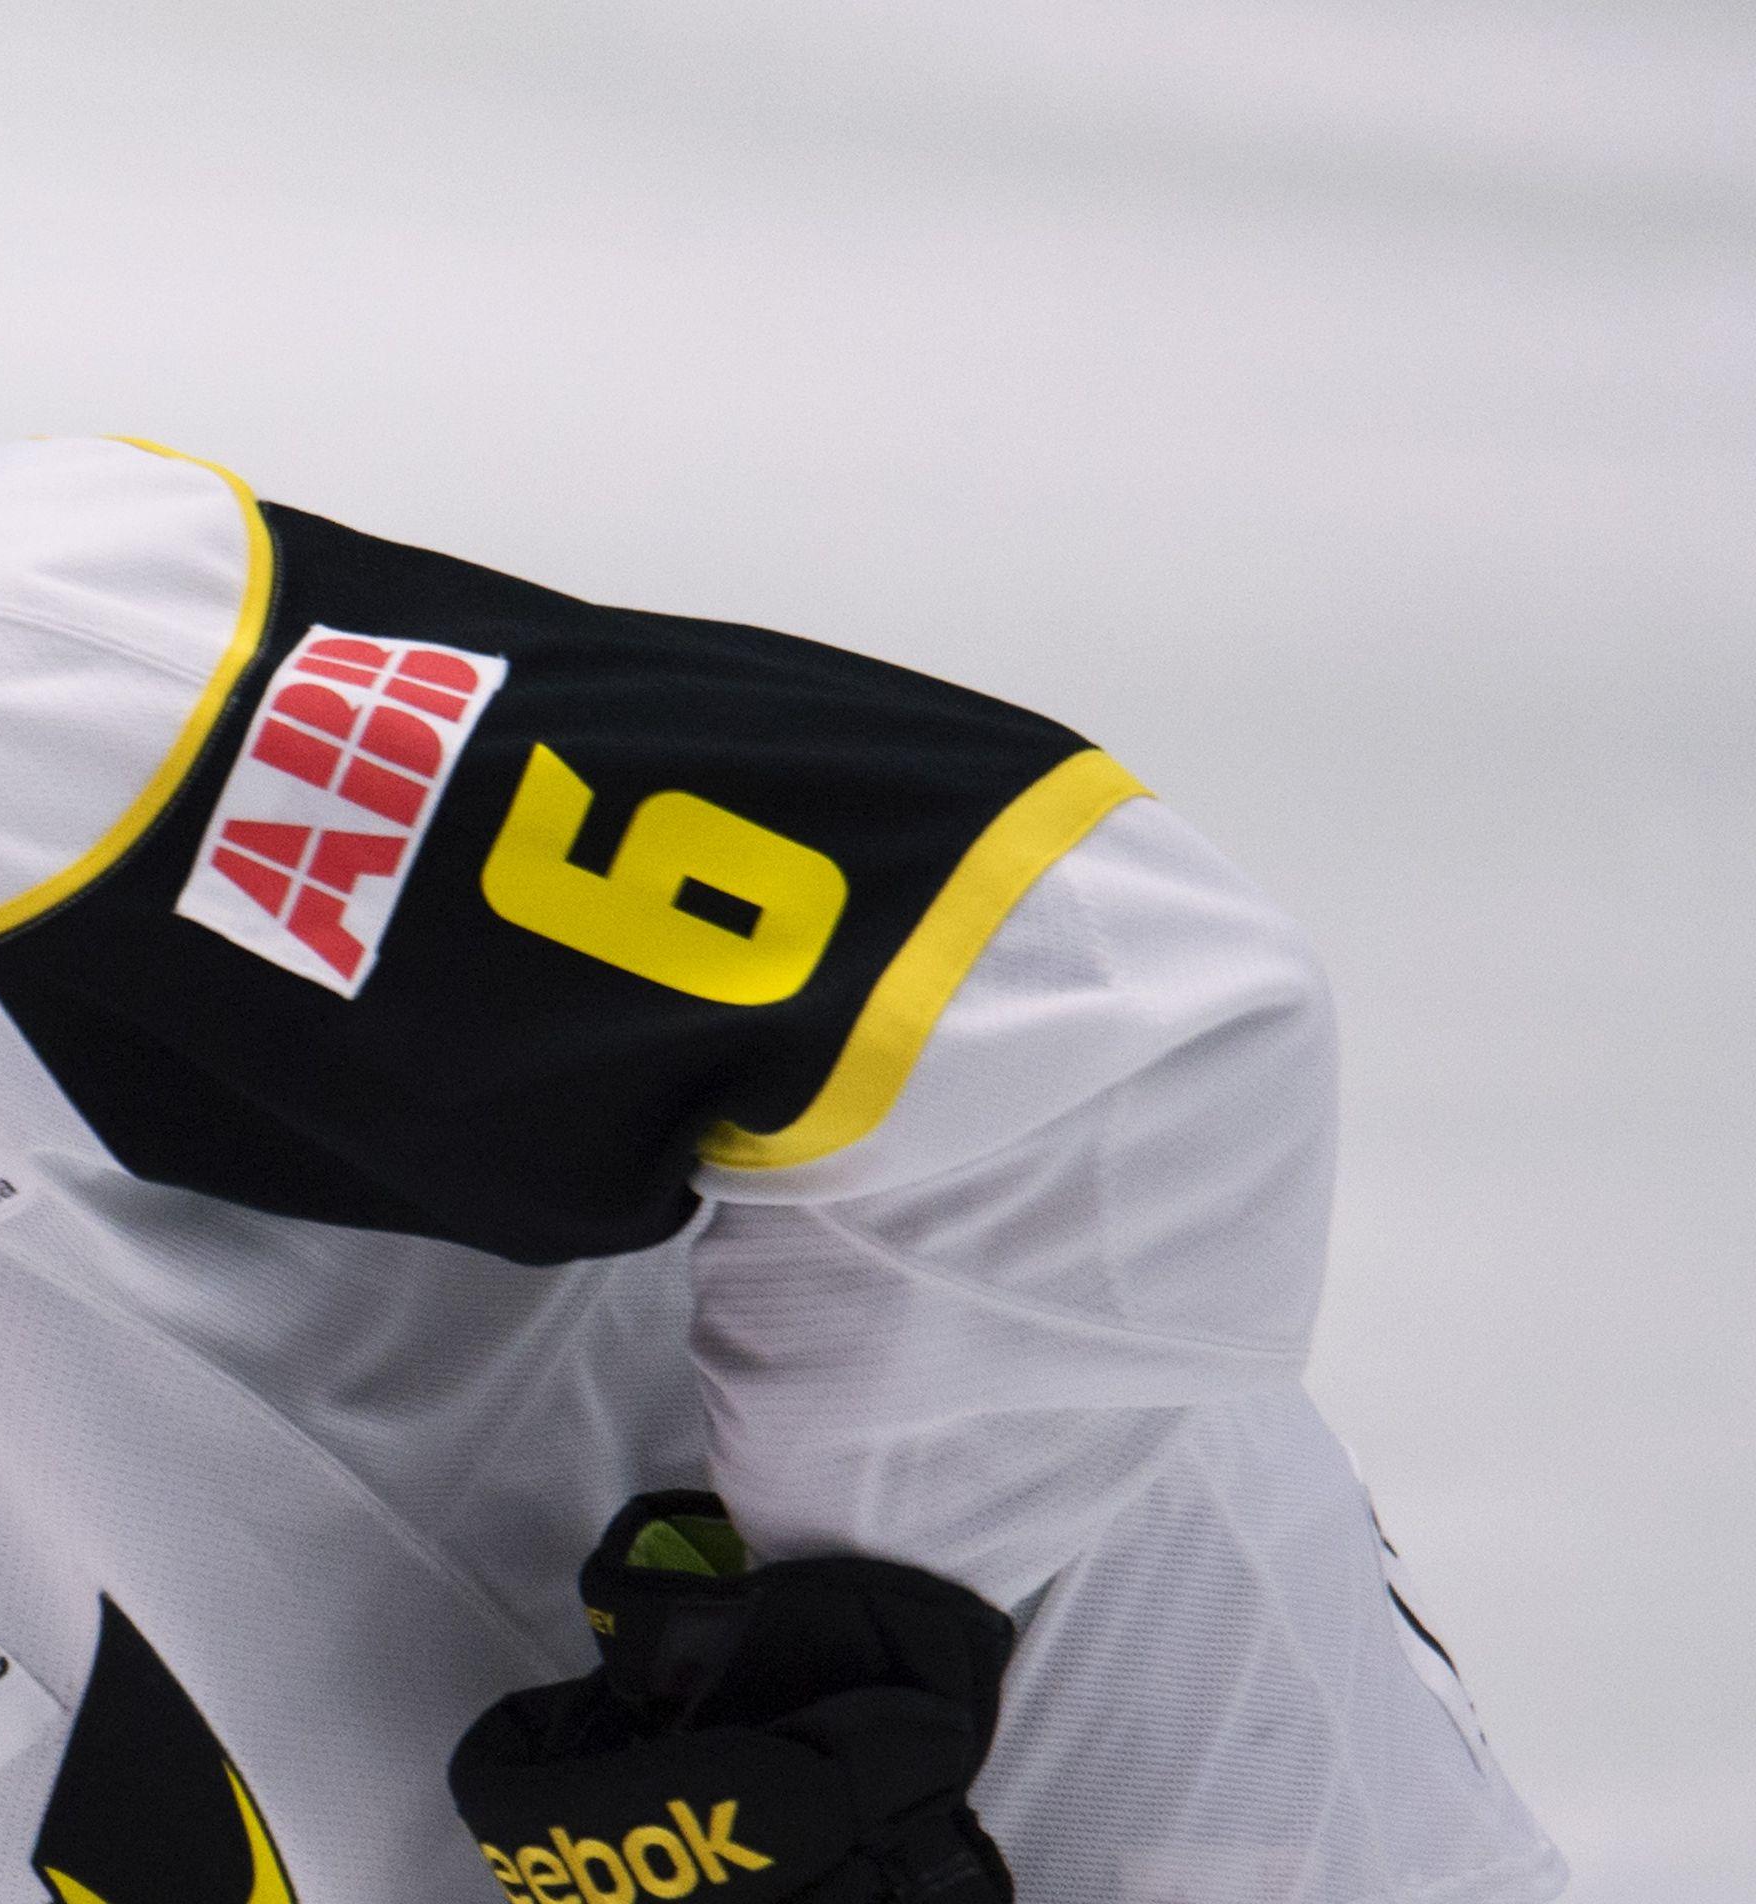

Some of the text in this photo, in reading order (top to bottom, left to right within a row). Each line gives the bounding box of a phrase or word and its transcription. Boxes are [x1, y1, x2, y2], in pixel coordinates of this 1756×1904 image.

[209, 637, 480, 983] ABB
[480, 741, 849, 1007] 6
[478, 1798, 777, 1904] eebok
